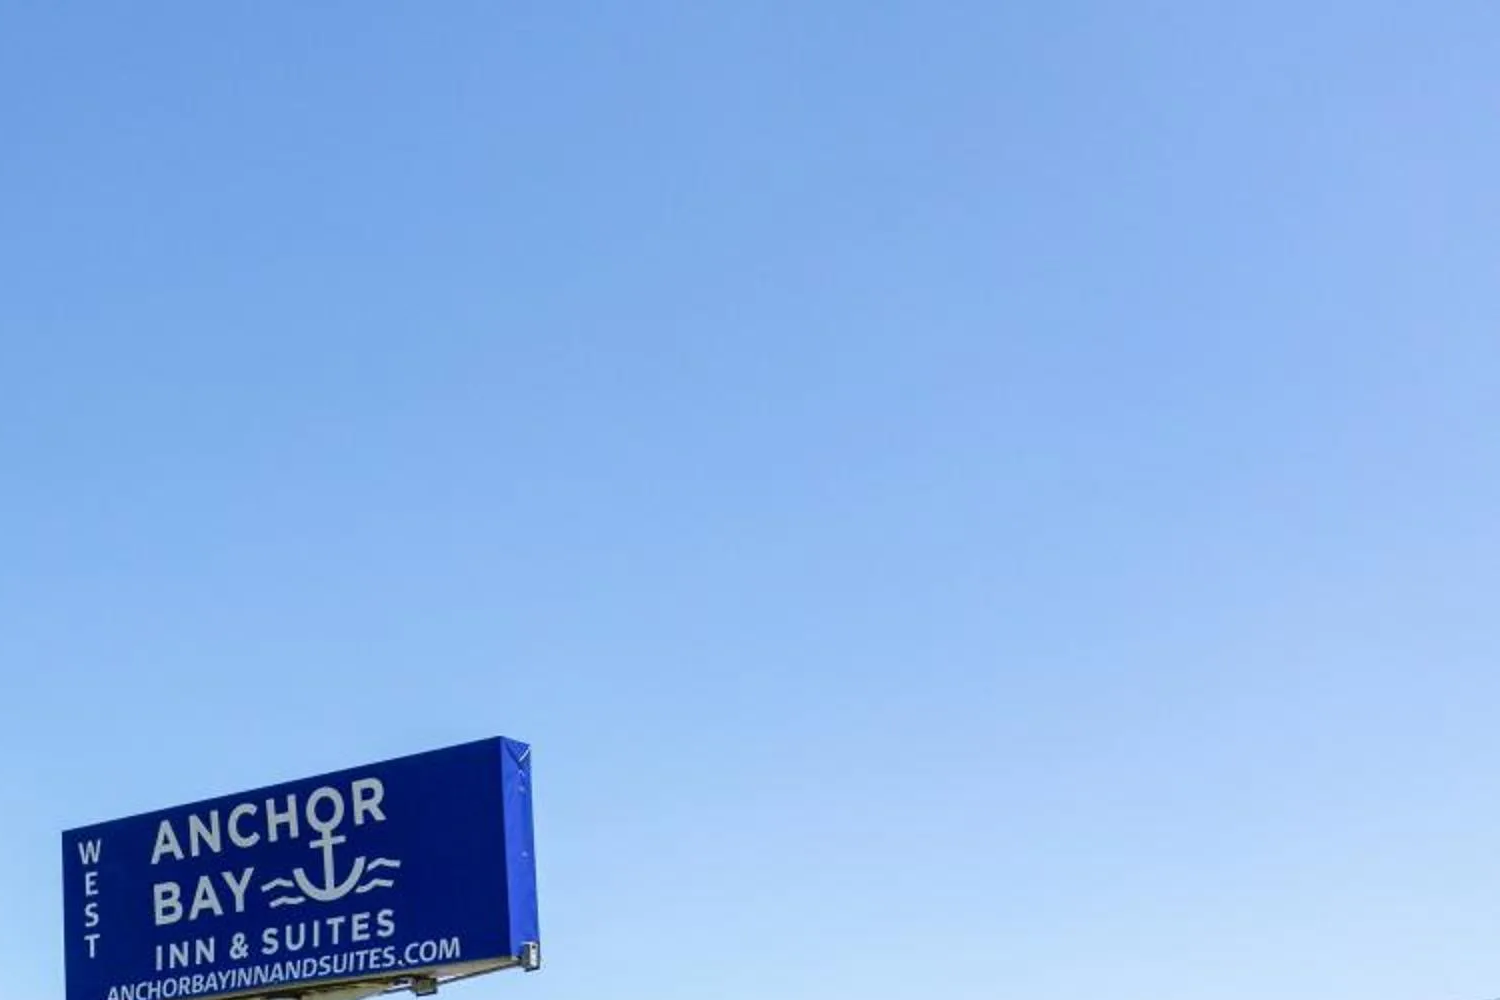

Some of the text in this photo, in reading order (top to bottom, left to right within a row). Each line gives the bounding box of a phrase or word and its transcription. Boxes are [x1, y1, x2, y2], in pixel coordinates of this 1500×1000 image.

[151, 777, 386, 865] ANCHOR
[78, 839, 101, 959] WEST
[153, 867, 254, 926] BAY
[156, 909, 395, 971] INN & SUITES
